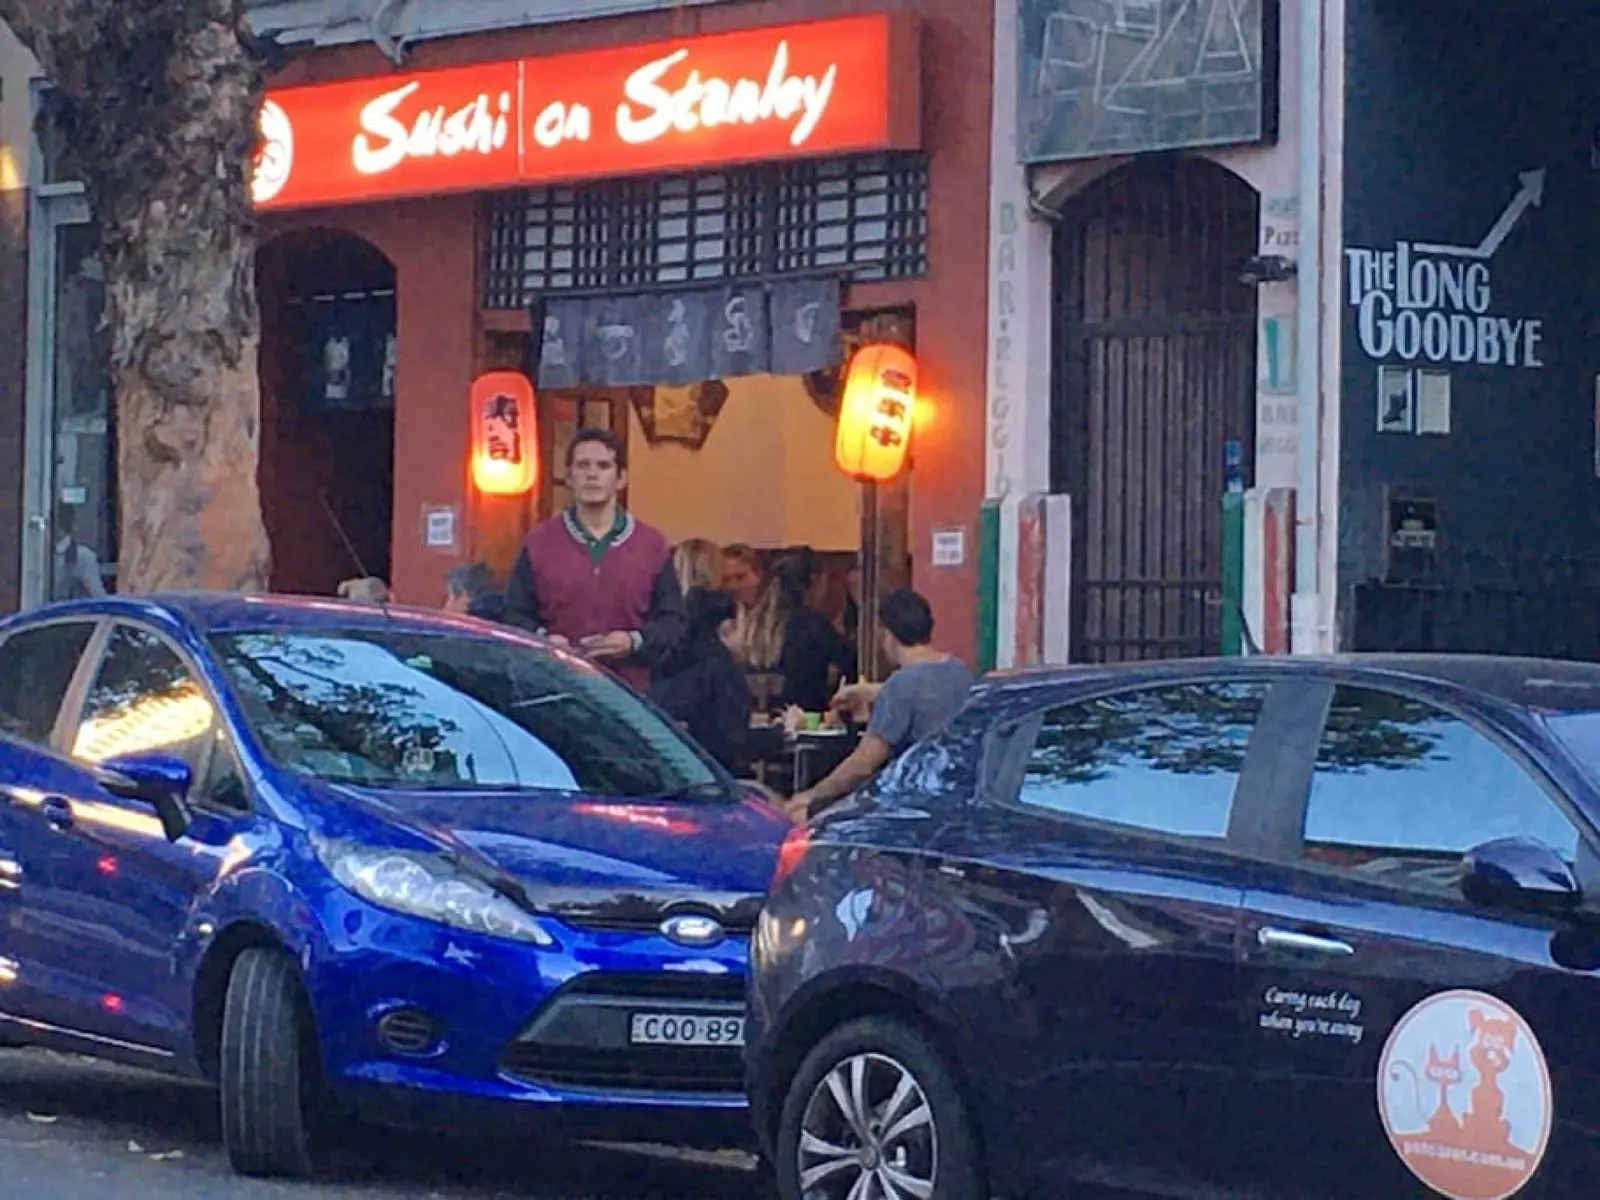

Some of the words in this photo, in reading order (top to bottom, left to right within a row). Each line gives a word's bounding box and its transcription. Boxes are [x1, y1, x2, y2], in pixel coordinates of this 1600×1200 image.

[352, 81, 508, 174] Sushi
[533, 101, 590, 148] on
[615, 40, 838, 146] Stanley
[1345, 248, 1395, 304] THE
[1396, 241, 1491, 313] LONG
[1358, 290, 1544, 367] GOODBYE
[1264, 986, 1307, 1012] Caring
